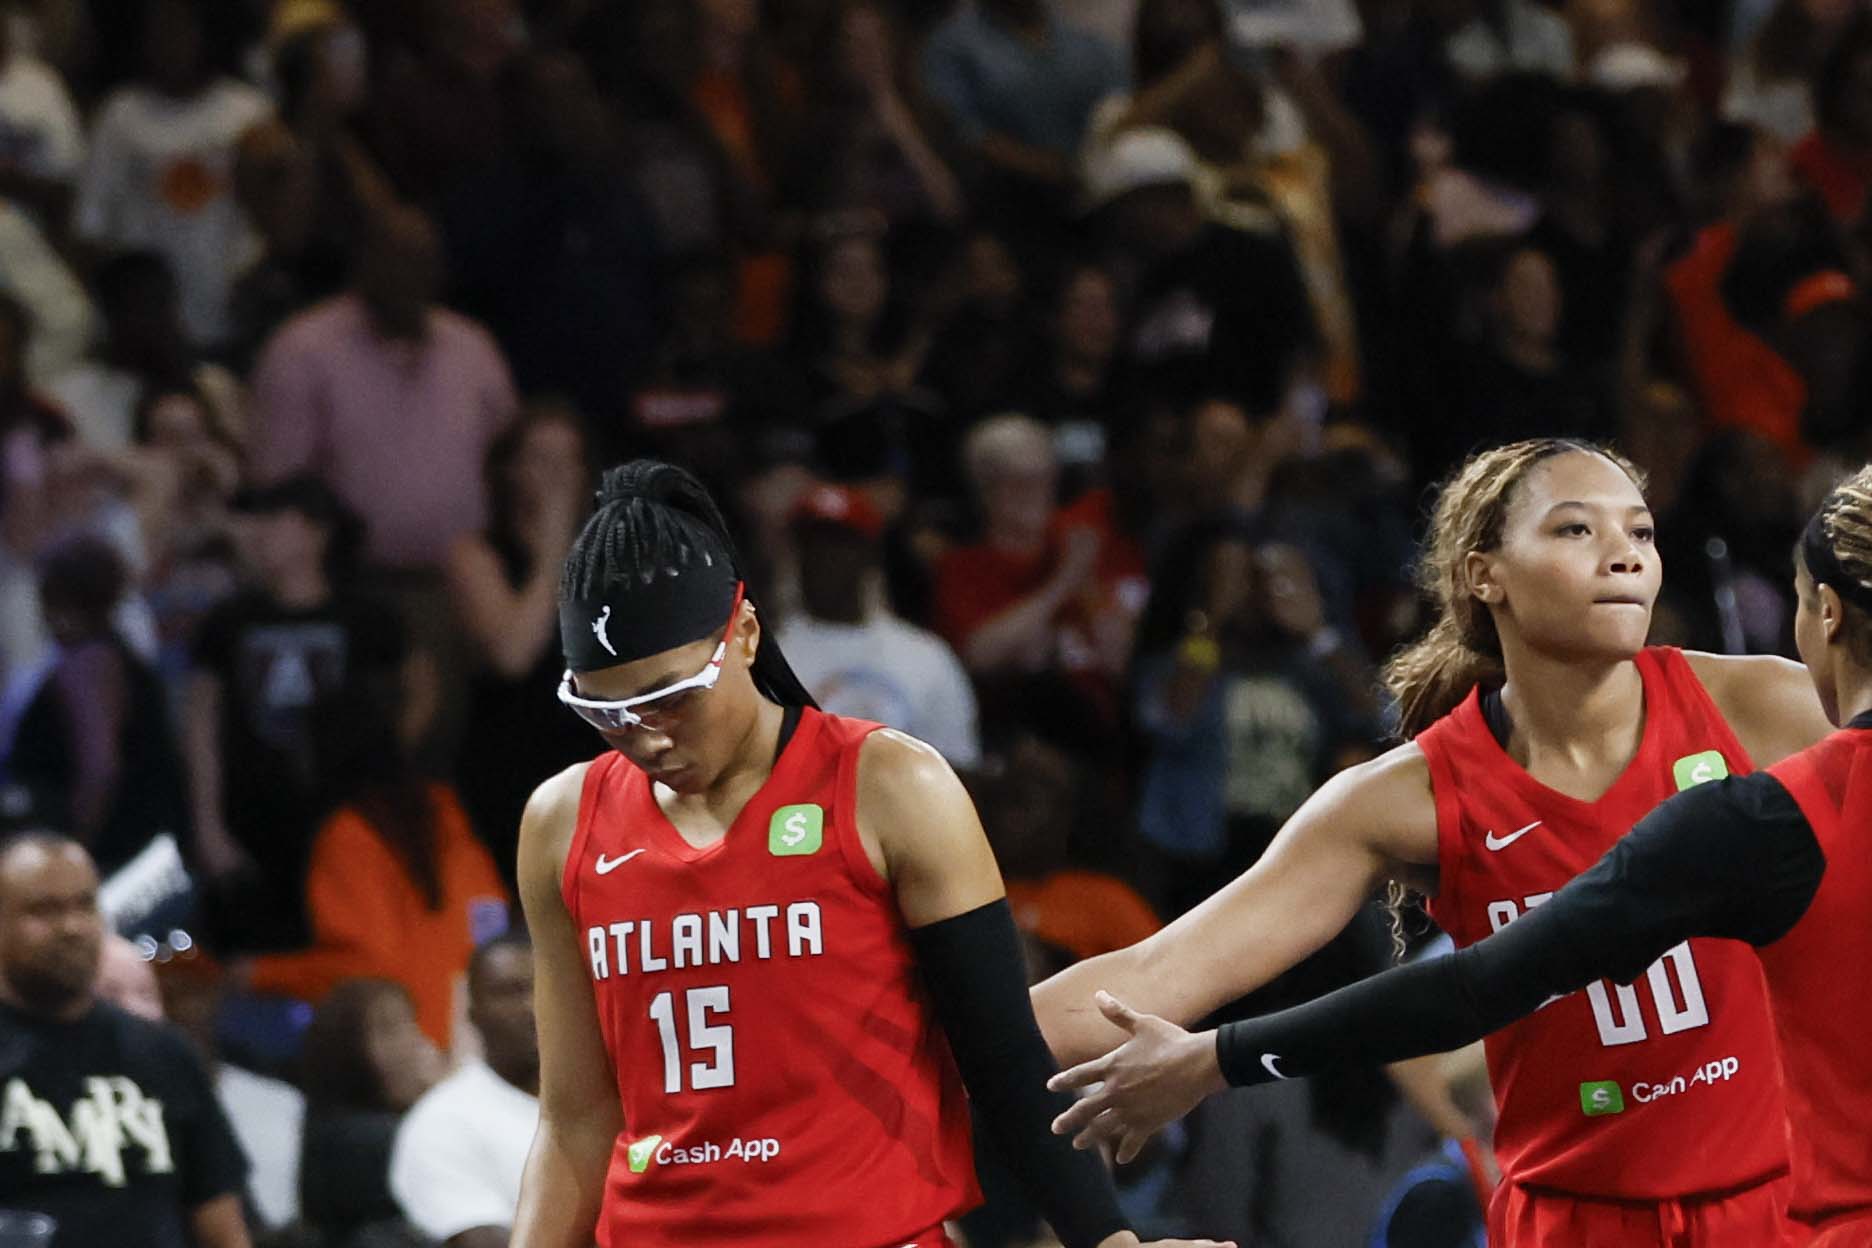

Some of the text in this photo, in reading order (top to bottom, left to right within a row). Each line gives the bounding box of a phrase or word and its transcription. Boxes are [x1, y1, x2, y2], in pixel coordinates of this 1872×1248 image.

[588, 901, 823, 980] ATLANTA
[649, 985, 735, 1093] 15
[1689, 1056, 1739, 1087] App
[655, 1137, 780, 1165] Cash App
